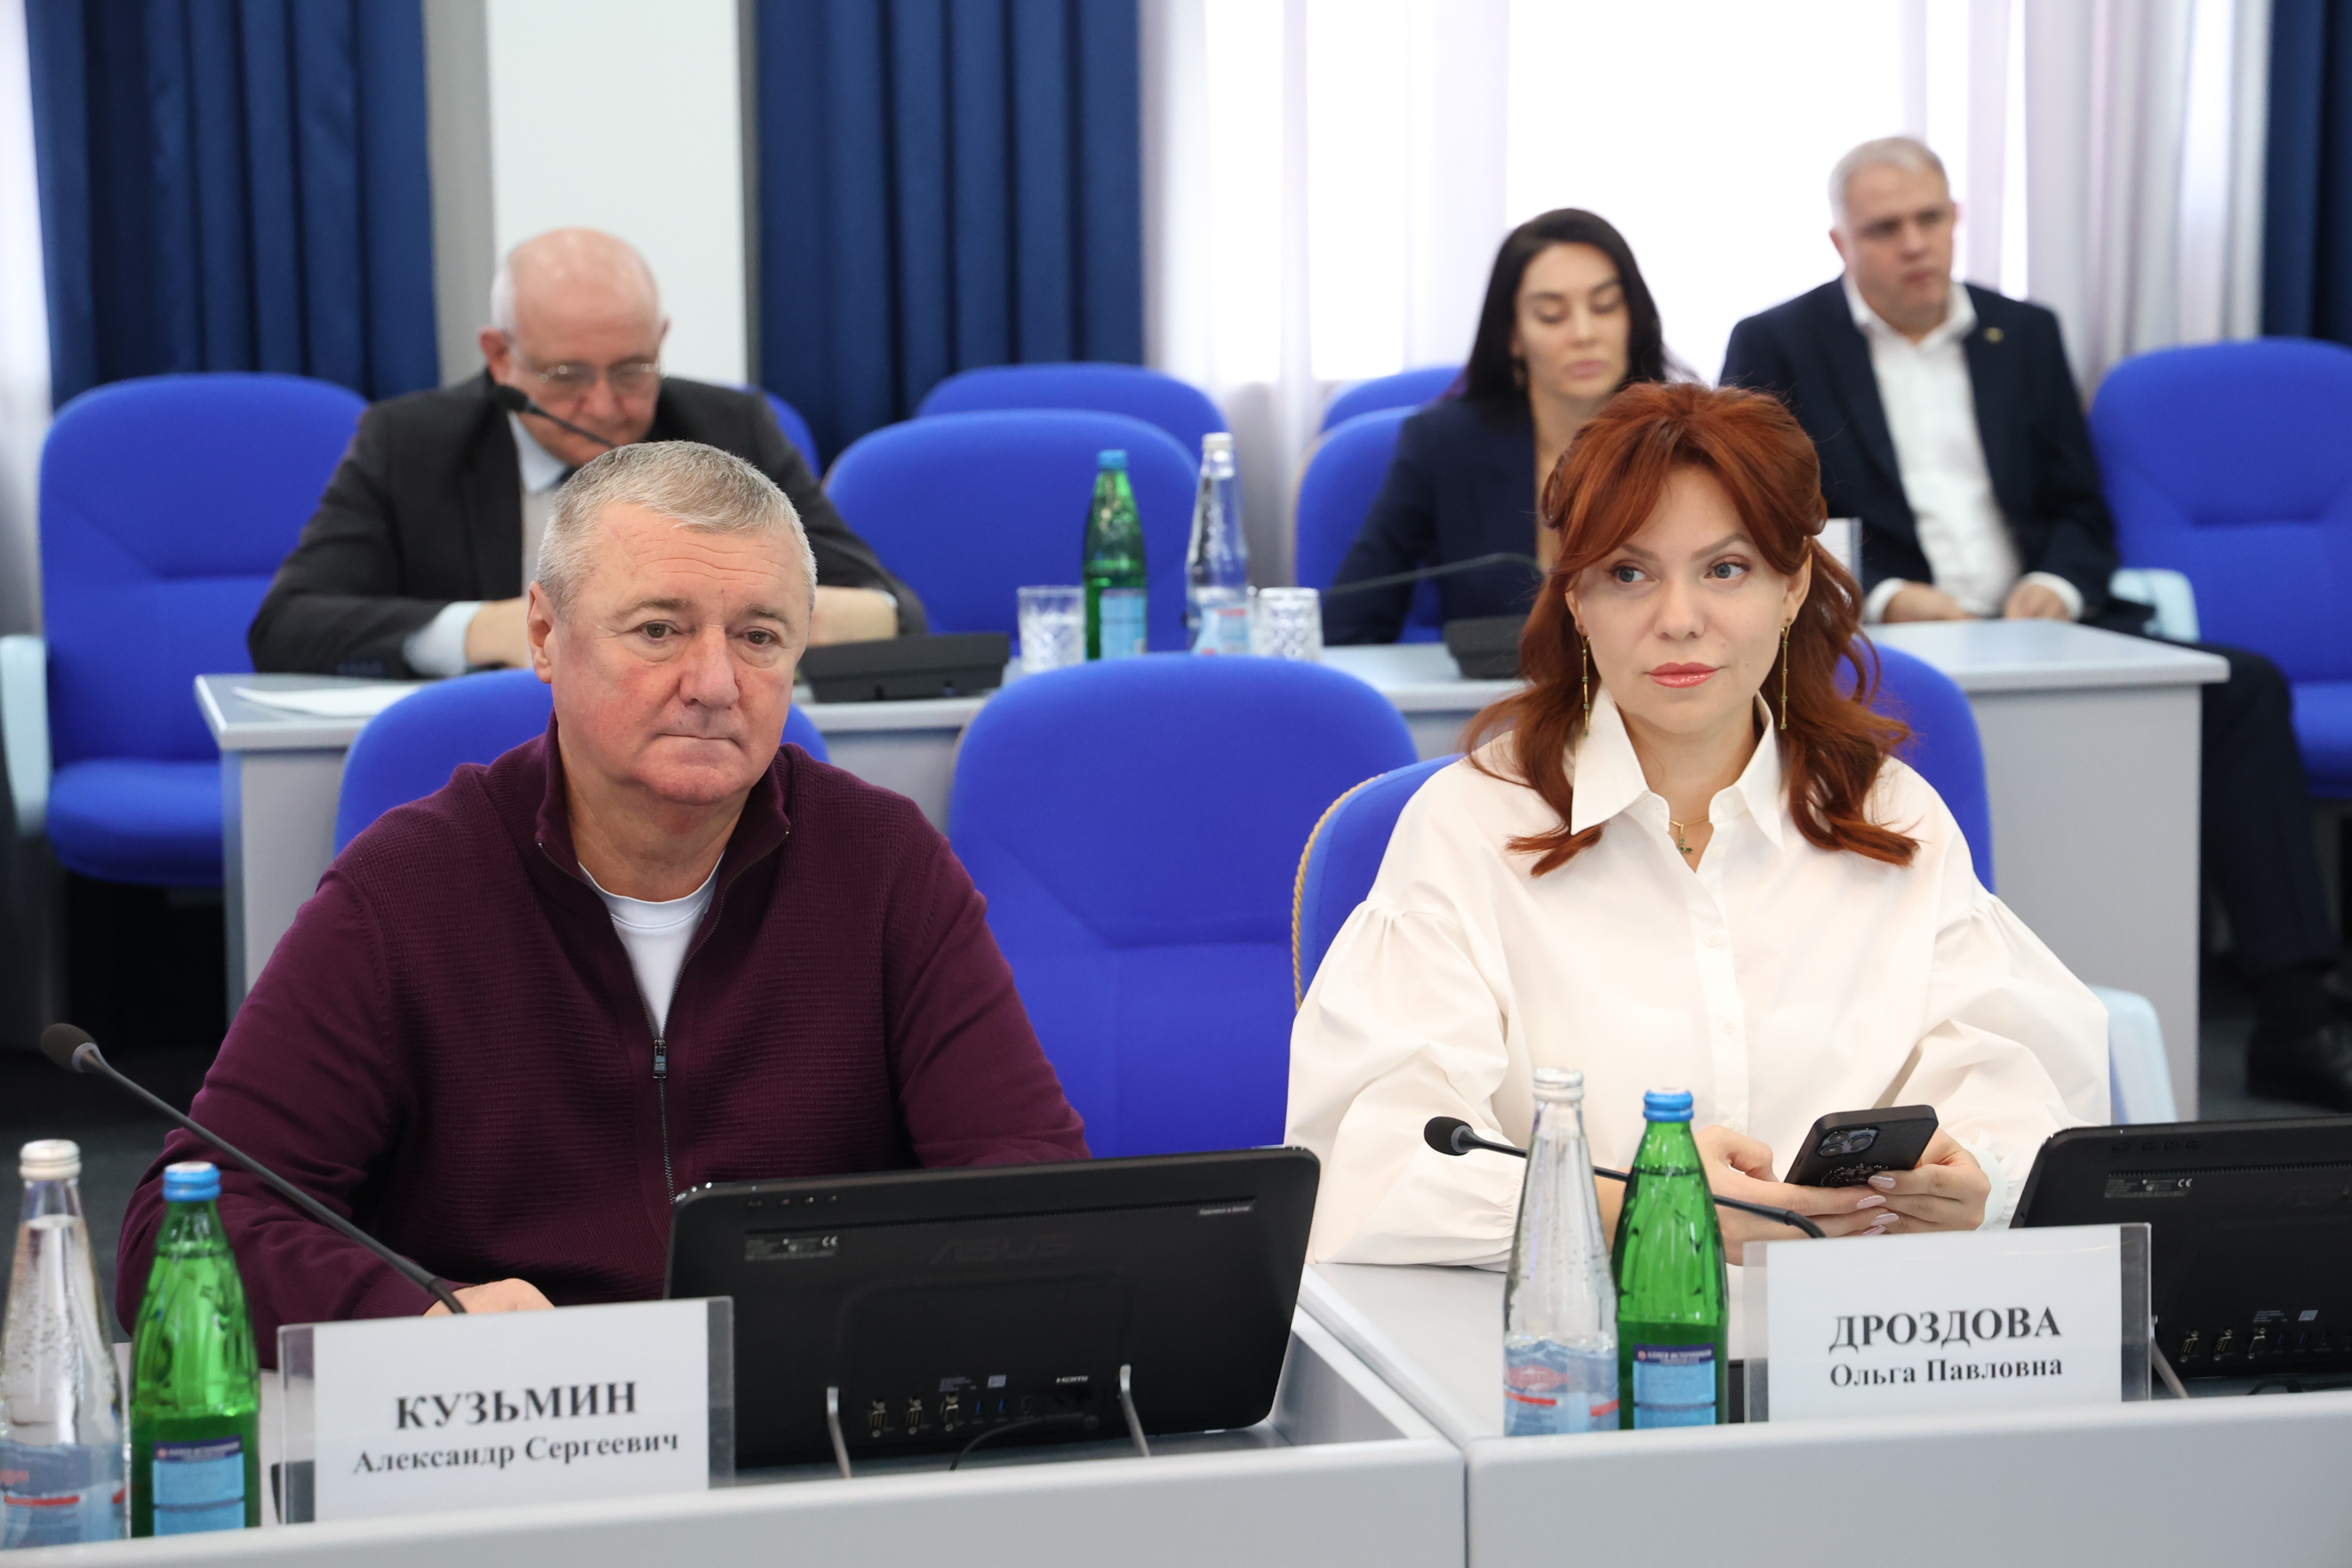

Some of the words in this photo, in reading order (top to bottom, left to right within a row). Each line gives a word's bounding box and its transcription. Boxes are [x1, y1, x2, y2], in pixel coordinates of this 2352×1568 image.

[928, 1232, 1075, 1265] ASUS
[1828, 1306, 2061, 1353] ДРОЗДОВА
[1829, 1364, 1916, 1387] Ольга
[1926, 1358, 2063, 1382] Павловна
[395, 1381, 638, 1430] КУЗЬМИН
[352, 1446, 516, 1474] Александр
[524, 1433, 679, 1466] Сергеевич
